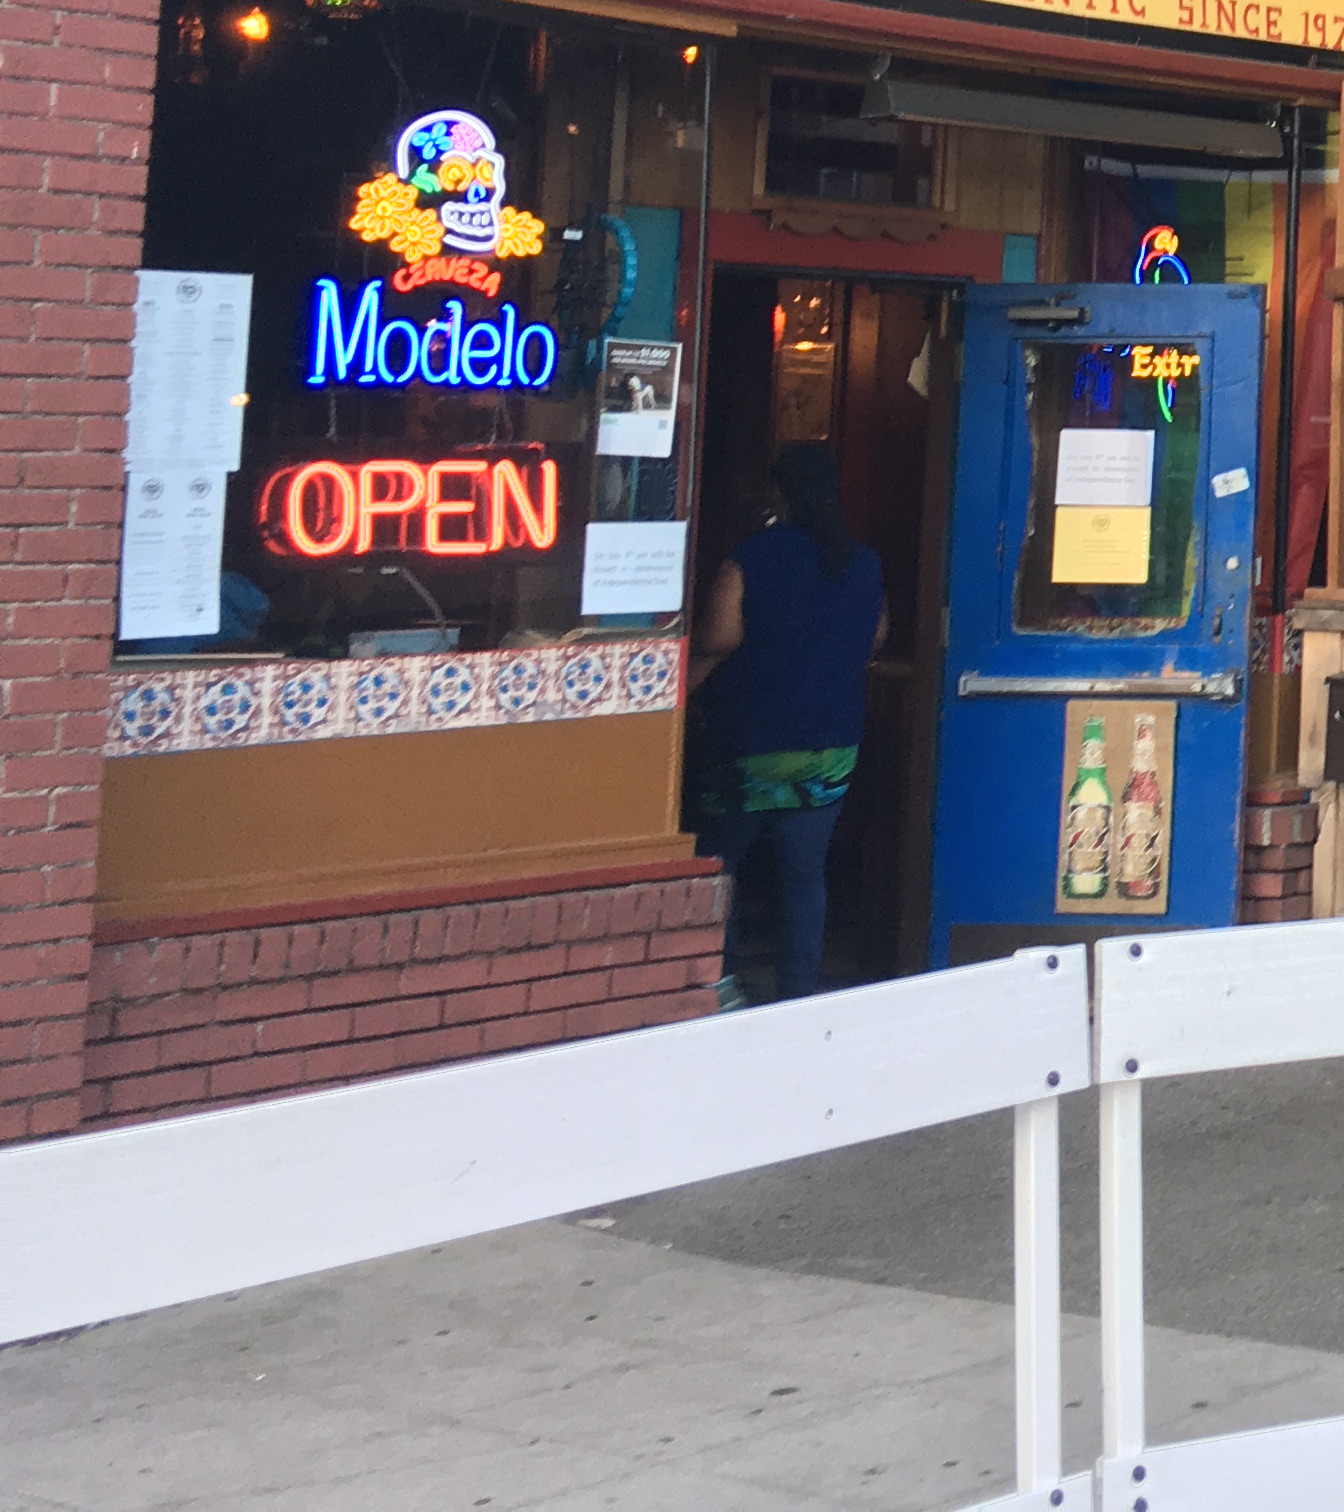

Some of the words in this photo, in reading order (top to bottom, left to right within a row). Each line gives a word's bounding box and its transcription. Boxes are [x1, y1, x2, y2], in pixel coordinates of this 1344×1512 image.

[392, 257, 502, 299] CERVEZA
[306, 276, 557, 387] Modelo
[1130, 344, 1201, 378] Extr
[286, 458, 558, 556] OPEN
